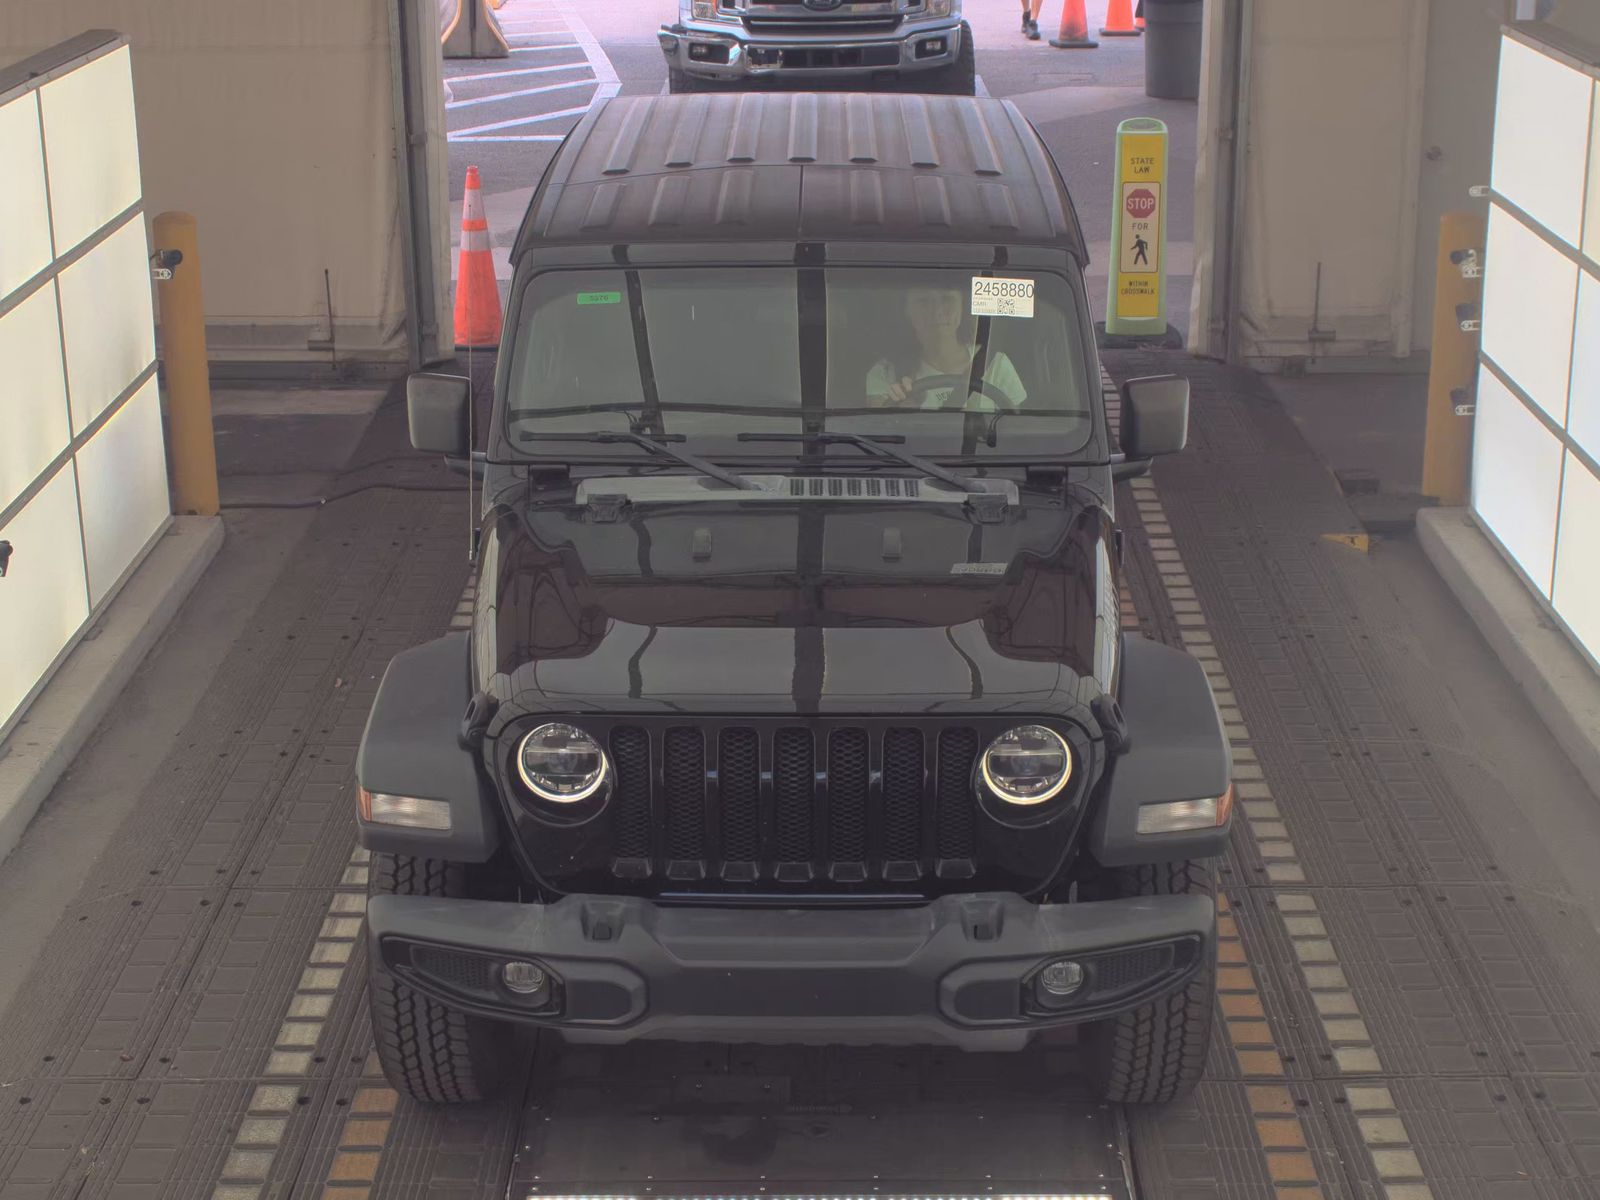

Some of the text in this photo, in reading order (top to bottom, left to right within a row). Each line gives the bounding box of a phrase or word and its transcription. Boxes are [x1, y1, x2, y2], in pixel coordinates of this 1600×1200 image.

[1130, 157, 1155, 165] STATE
[1134, 166, 1150, 174] LAW
[1127, 198, 1155, 210] STOP
[1132, 222, 1149, 231] FOR
[974, 281, 1034, 298] 2458880
